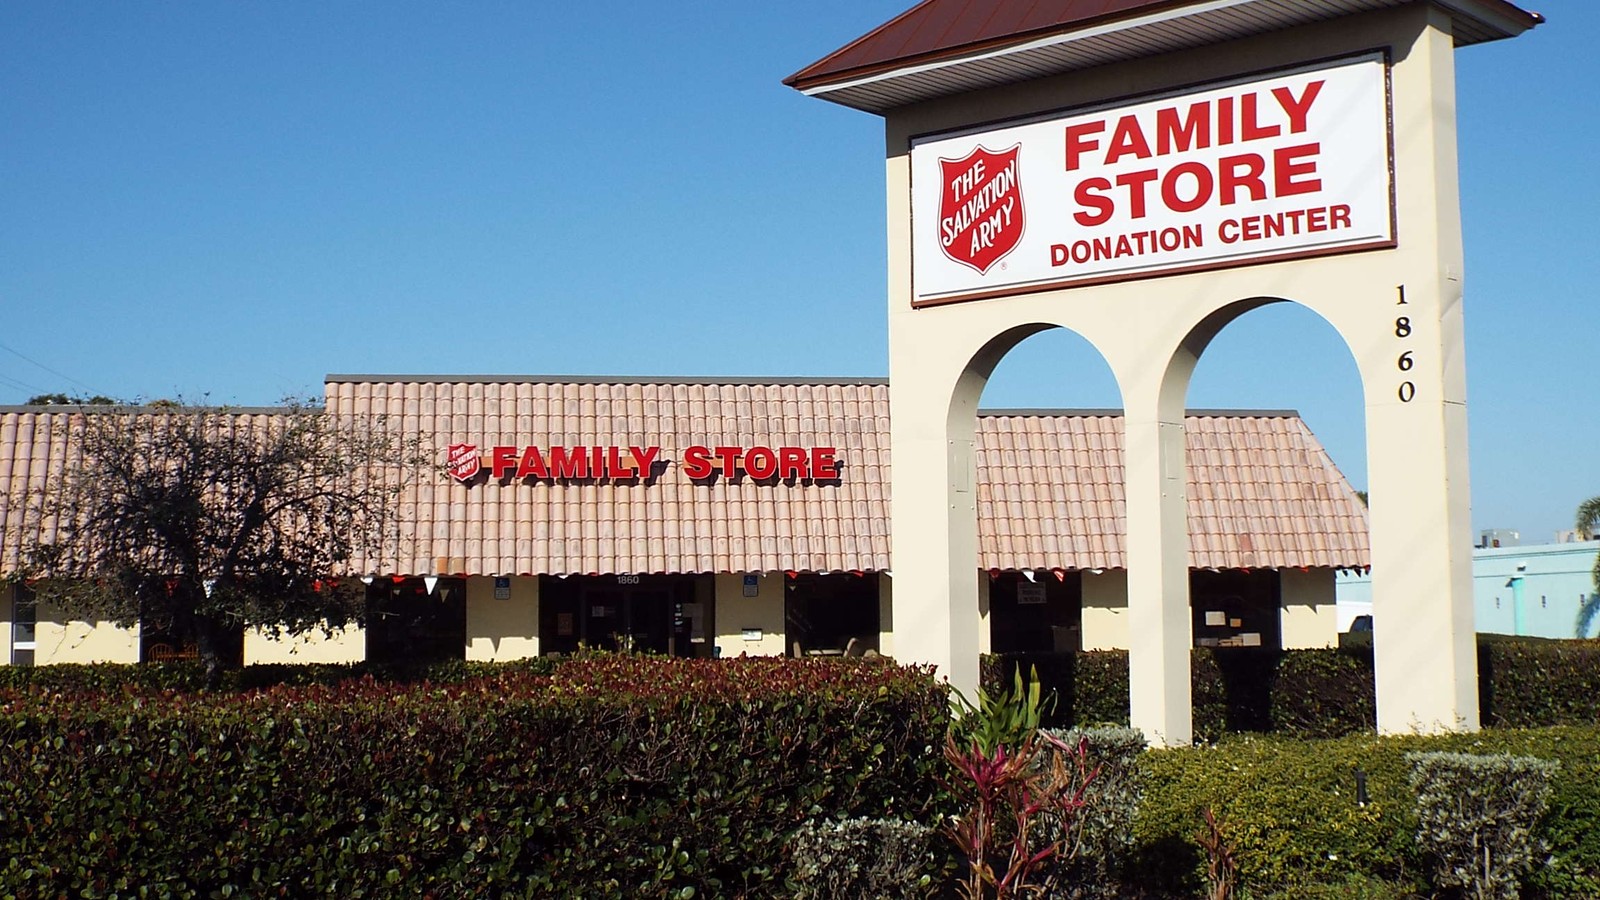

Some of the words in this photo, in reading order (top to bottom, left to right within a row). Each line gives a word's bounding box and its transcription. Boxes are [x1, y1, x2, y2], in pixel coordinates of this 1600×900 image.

[1065, 80, 1326, 171] FAMILY
[942, 160, 1015, 246] SALVATION
[951, 159, 986, 202] THE
[1073, 142, 1323, 227] STORE
[970, 196, 1014, 258] ARMY
[1050, 224, 1203, 267] DONATION
[1218, 204, 1352, 244] CENTER
[1395, 284, 1416, 403] 1860
[452, 446, 465, 459] THE
[457, 458, 475, 476] ARMY
[492, 445, 661, 479] FAMILY
[683, 445, 838, 480] STORE
[617, 575, 639, 585] 1860
